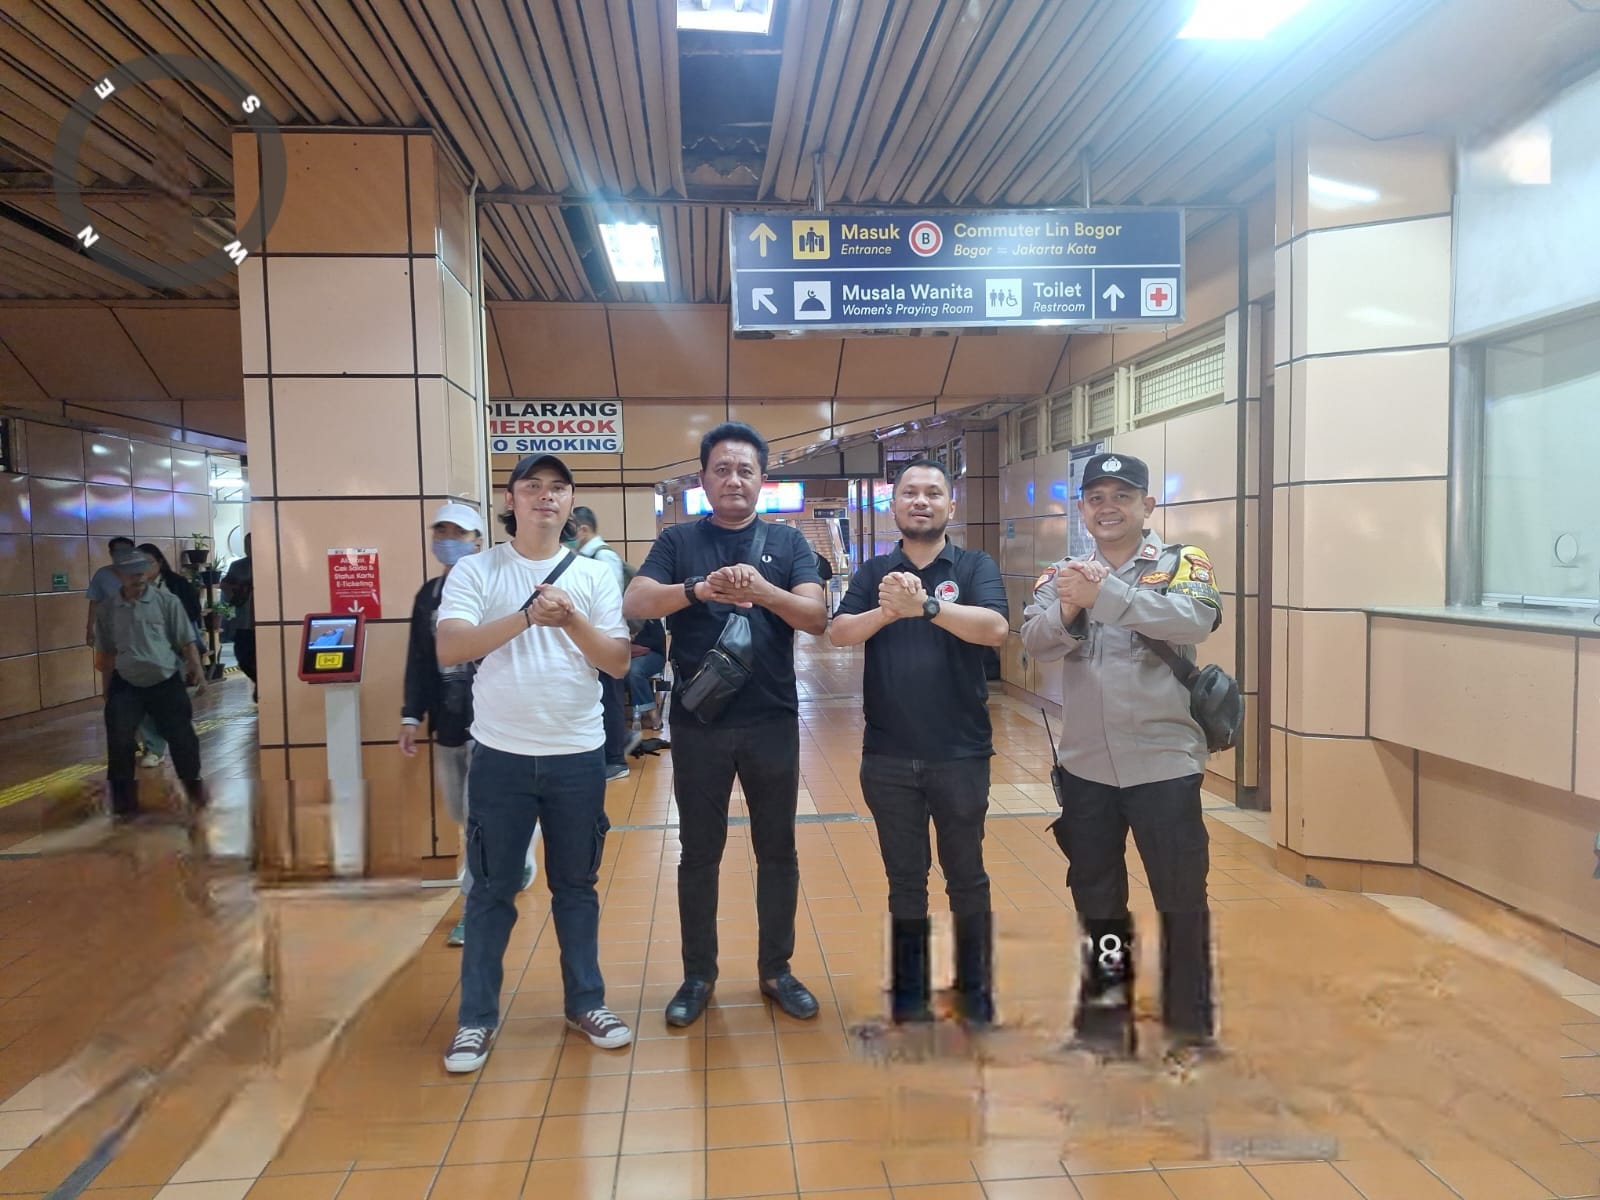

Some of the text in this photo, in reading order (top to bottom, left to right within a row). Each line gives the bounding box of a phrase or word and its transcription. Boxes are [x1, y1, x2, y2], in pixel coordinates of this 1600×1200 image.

[841, 224, 900, 240] Masuk
[953, 222, 1122, 240] Commuter Lin Bogor
[921, 232, 931, 245] B
[841, 244, 892, 255] Entrance
[953, 244, 992, 259] Bogor
[1012, 243, 1063, 256] Jakarta
[1067, 242, 1097, 255] Kota
[842, 282, 973, 301] Musala Wanita
[1032, 282, 1082, 297] Toilet
[842, 303, 974, 317] Women's Praying Room
[1032, 302, 1086, 313] Restroom
[489, 403, 618, 417] ILARANG
[516, 439, 617, 452] SMOKING
